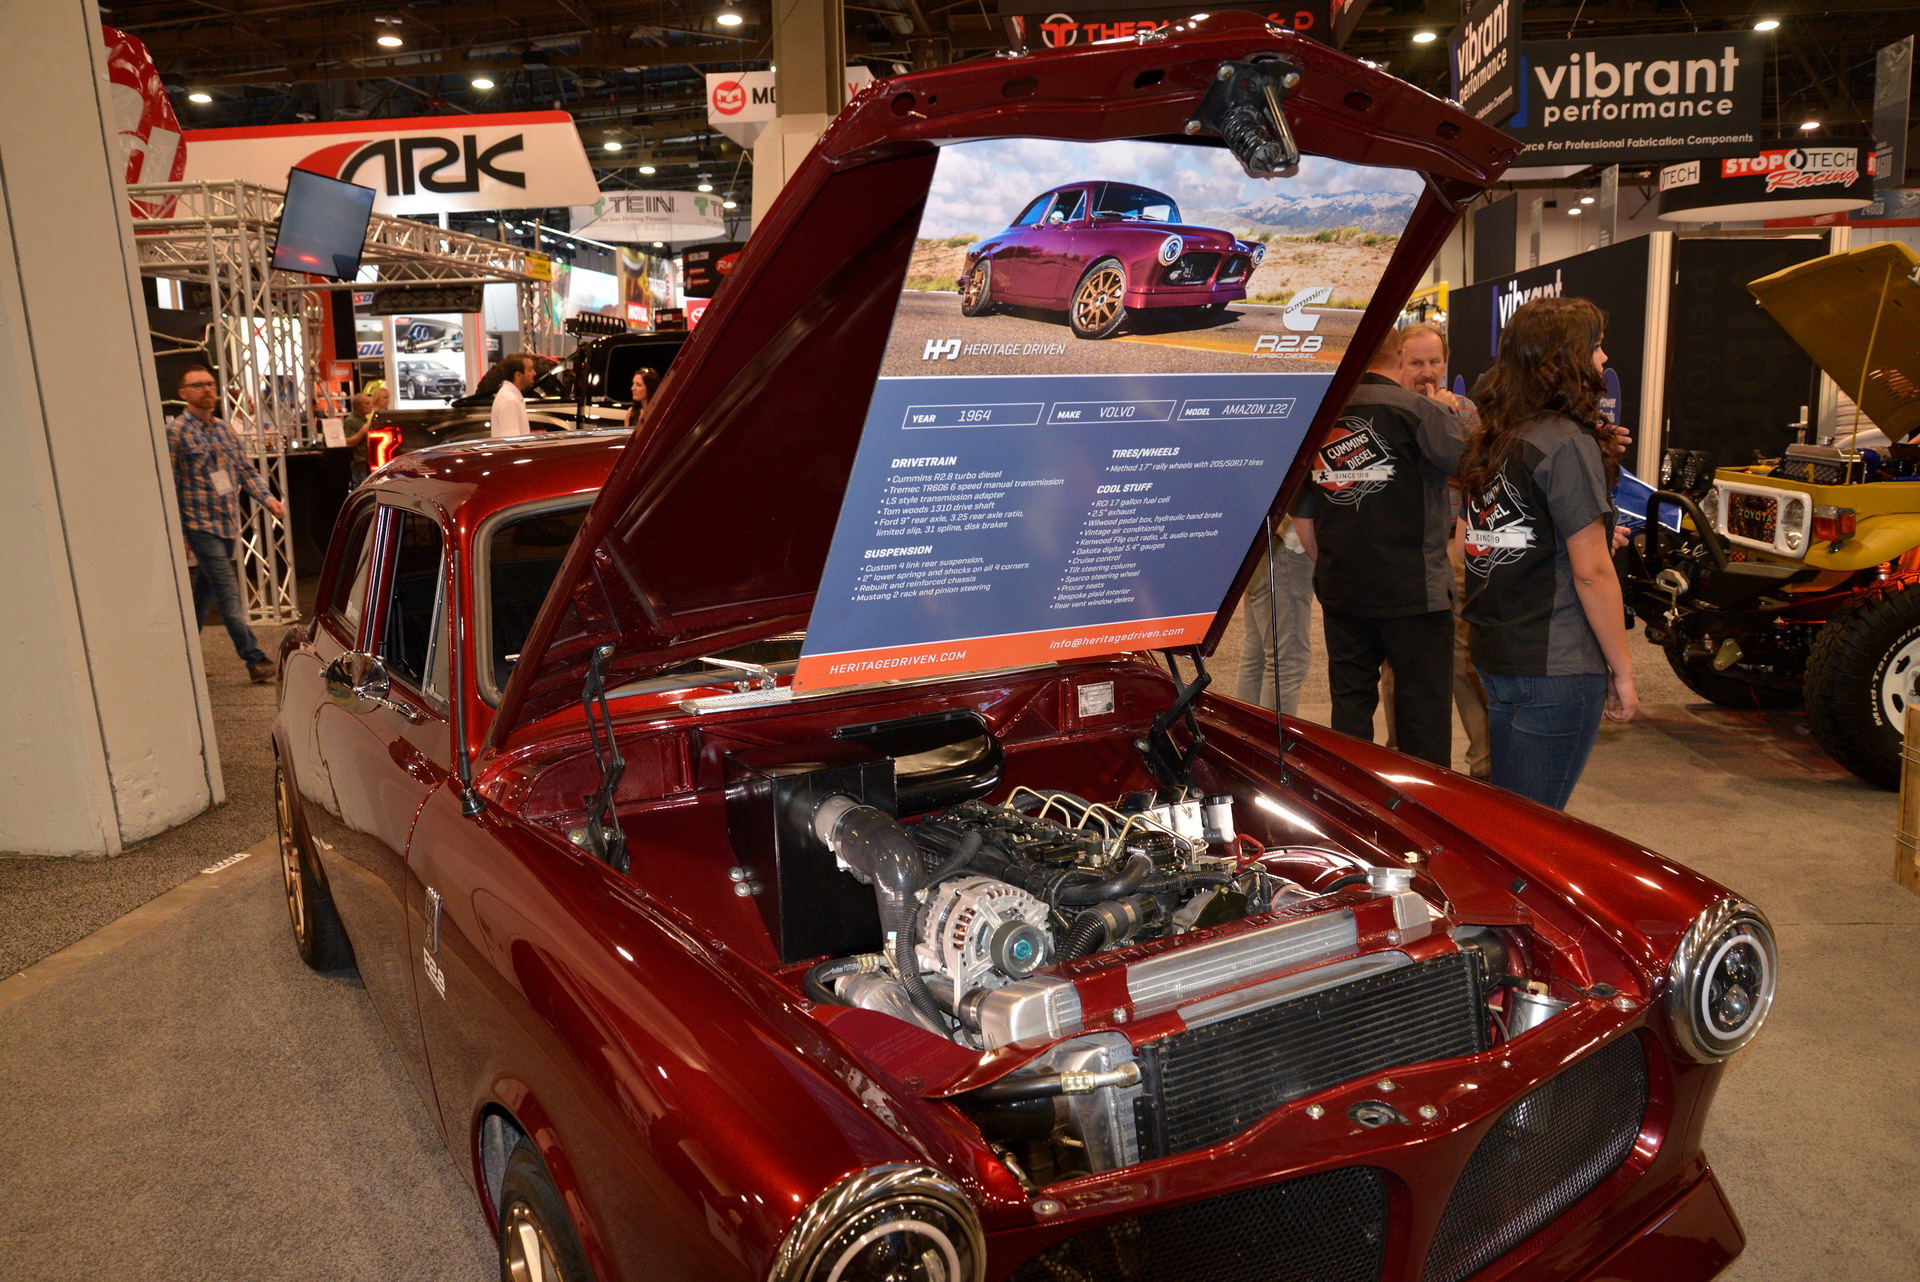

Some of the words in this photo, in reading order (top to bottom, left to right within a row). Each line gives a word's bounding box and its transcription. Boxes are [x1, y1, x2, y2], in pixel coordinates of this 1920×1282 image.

[1457, 0, 1509, 81] vibrant
[1460, 48, 1507, 105] performance
[1534, 46, 1739, 100] vibrant
[1544, 98, 1734, 127] performance
[1547, 141, 1563, 150] For
[1565, 138, 1624, 150] Professional
[1628, 136, 1684, 148] Fabrication
[1687, 133, 1753, 146] Components
[340, 134, 526, 196] ARK
[1725, 154, 1784, 174] STOP
[1766, 169, 1860, 192] Racing
[609, 196, 674, 214] TEIN
[1285, 288, 1329, 314] Cummins
[963, 344, 1021, 355] HERITAGE
[1023, 343, 1066, 355] DRIVEN
[1253, 335, 1323, 352] R2.8
[912, 415, 936, 423] YEAR
[958, 410, 991, 422] 1964
[1100, 406, 1135, 418] VOLVO
[1185, 408, 1210, 416] MODEL
[1222, 404, 1266, 415] AMAZON
[1267, 403, 1288, 414] 122
[1112, 447, 1180, 458] TIRES/WHEELS
[1327, 433, 1369, 459] CUMMINS
[891, 456, 957, 468] DRIVETRAIN
[1152, 462, 1168, 471] rally
[1169, 461, 1193, 469] wheels
[1346, 448, 1376, 470] DIESEL
[892, 475, 932, 483] Cummins
[978, 470, 1002, 479] diesel
[890, 486, 920, 494] Tremec
[922, 484, 949, 492] TR606
[958, 481, 983, 492] speed
[984, 480, 1013, 488] manual
[1014, 477, 1064, 487] transmission
[1097, 484, 1121, 494] COOL
[1123, 483, 1153, 492] STUFF
[898, 495, 918, 505] style
[920, 493, 972, 502] transmission
[974, 491, 1006, 501] adapter
[1120, 497, 1142, 507] gallon
[902, 506, 928, 514] woods
[953, 503, 973, 511] drive
[974, 501, 996, 510] shaft
[880, 518, 898, 526] Ford
[928, 514, 948, 523] axle,
[987, 511, 1003, 519] axle
[1004, 510, 1024, 518] ratio,
[1088, 517, 1117, 527] Wilwood
[1118, 517, 1138, 526] pedal
[1154, 514, 1185, 523] hydraulic
[1738, 508, 1772, 523] TOYOTA
[876, 528, 905, 536] limited
[906, 526, 922, 536] slip,
[937, 524, 962, 534] spline,
[964, 522, 980, 530] disk
[982, 520, 1008, 529] brakes
[1084, 527, 1110, 537] Vintage
[1123, 524, 1165, 534] conditioning
[1080, 538, 1112, 546] Kenwood
[1113, 536, 1127, 546] Flip
[1170, 531, 1188, 539] audio
[1189, 529, 1218, 539] amp/sub
[864, 545, 933, 559] SUSPENSION
[1076, 547, 1101, 555] Dakota
[1102, 545, 1125, 555] digital
[1140, 542, 1165, 552] gauges
[865, 564, 897, 572] Custom
[906, 561, 920, 569] link
[939, 557, 984, 567] suspension,
[1096, 555, 1121, 563] control
[874, 572, 895, 581] lower
[897, 570, 926, 580] springs
[944, 567, 971, 575] shocks
[1001, 562, 1029, 571] corners
[1081, 564, 1110, 573] steering
[1111, 562, 1136, 571] column
[860, 583, 888, 592] Rebuilt
[906, 579, 947, 588] reinforced
[948, 576, 976, 584] chassis
[1065, 574, 1089, 584] Sparco
[1091, 572, 1119, 582] steering
[1120, 570, 1140, 579] wheel
[856, 592, 891, 603] Mustang
[900, 589, 917, 598] rack
[935, 586, 959, 596] pinion
[960, 584, 991, 594] steering
[1058, 592, 1086, 602] Bespoke
[1087, 590, 1105, 600] plaid
[1106, 587, 1130, 596] interior
[1087, 597, 1113, 606] window
[1049, 626, 1184, 649] info@heritagedriven.com
[830, 651, 967, 675] HERITAGEDRIVEN.COM
